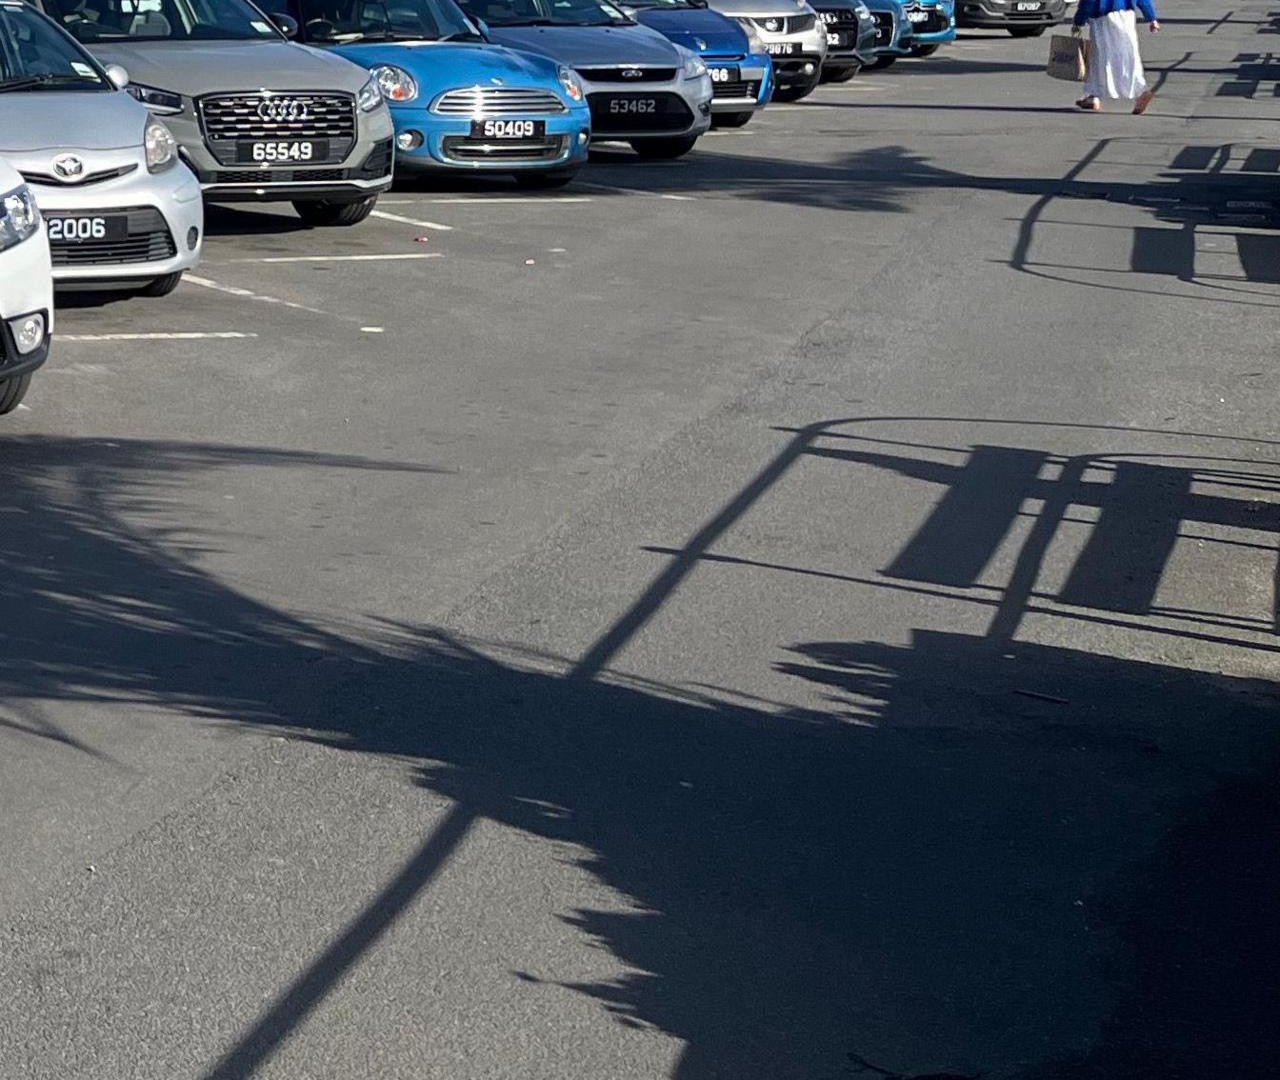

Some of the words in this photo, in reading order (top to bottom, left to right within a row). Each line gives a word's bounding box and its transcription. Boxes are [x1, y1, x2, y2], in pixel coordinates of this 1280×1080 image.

[610, 99, 656, 113] 53462
[484, 120, 534, 137] 50409
[252, 142, 313, 161] 65549
[44, 217, 106, 240] 2006
